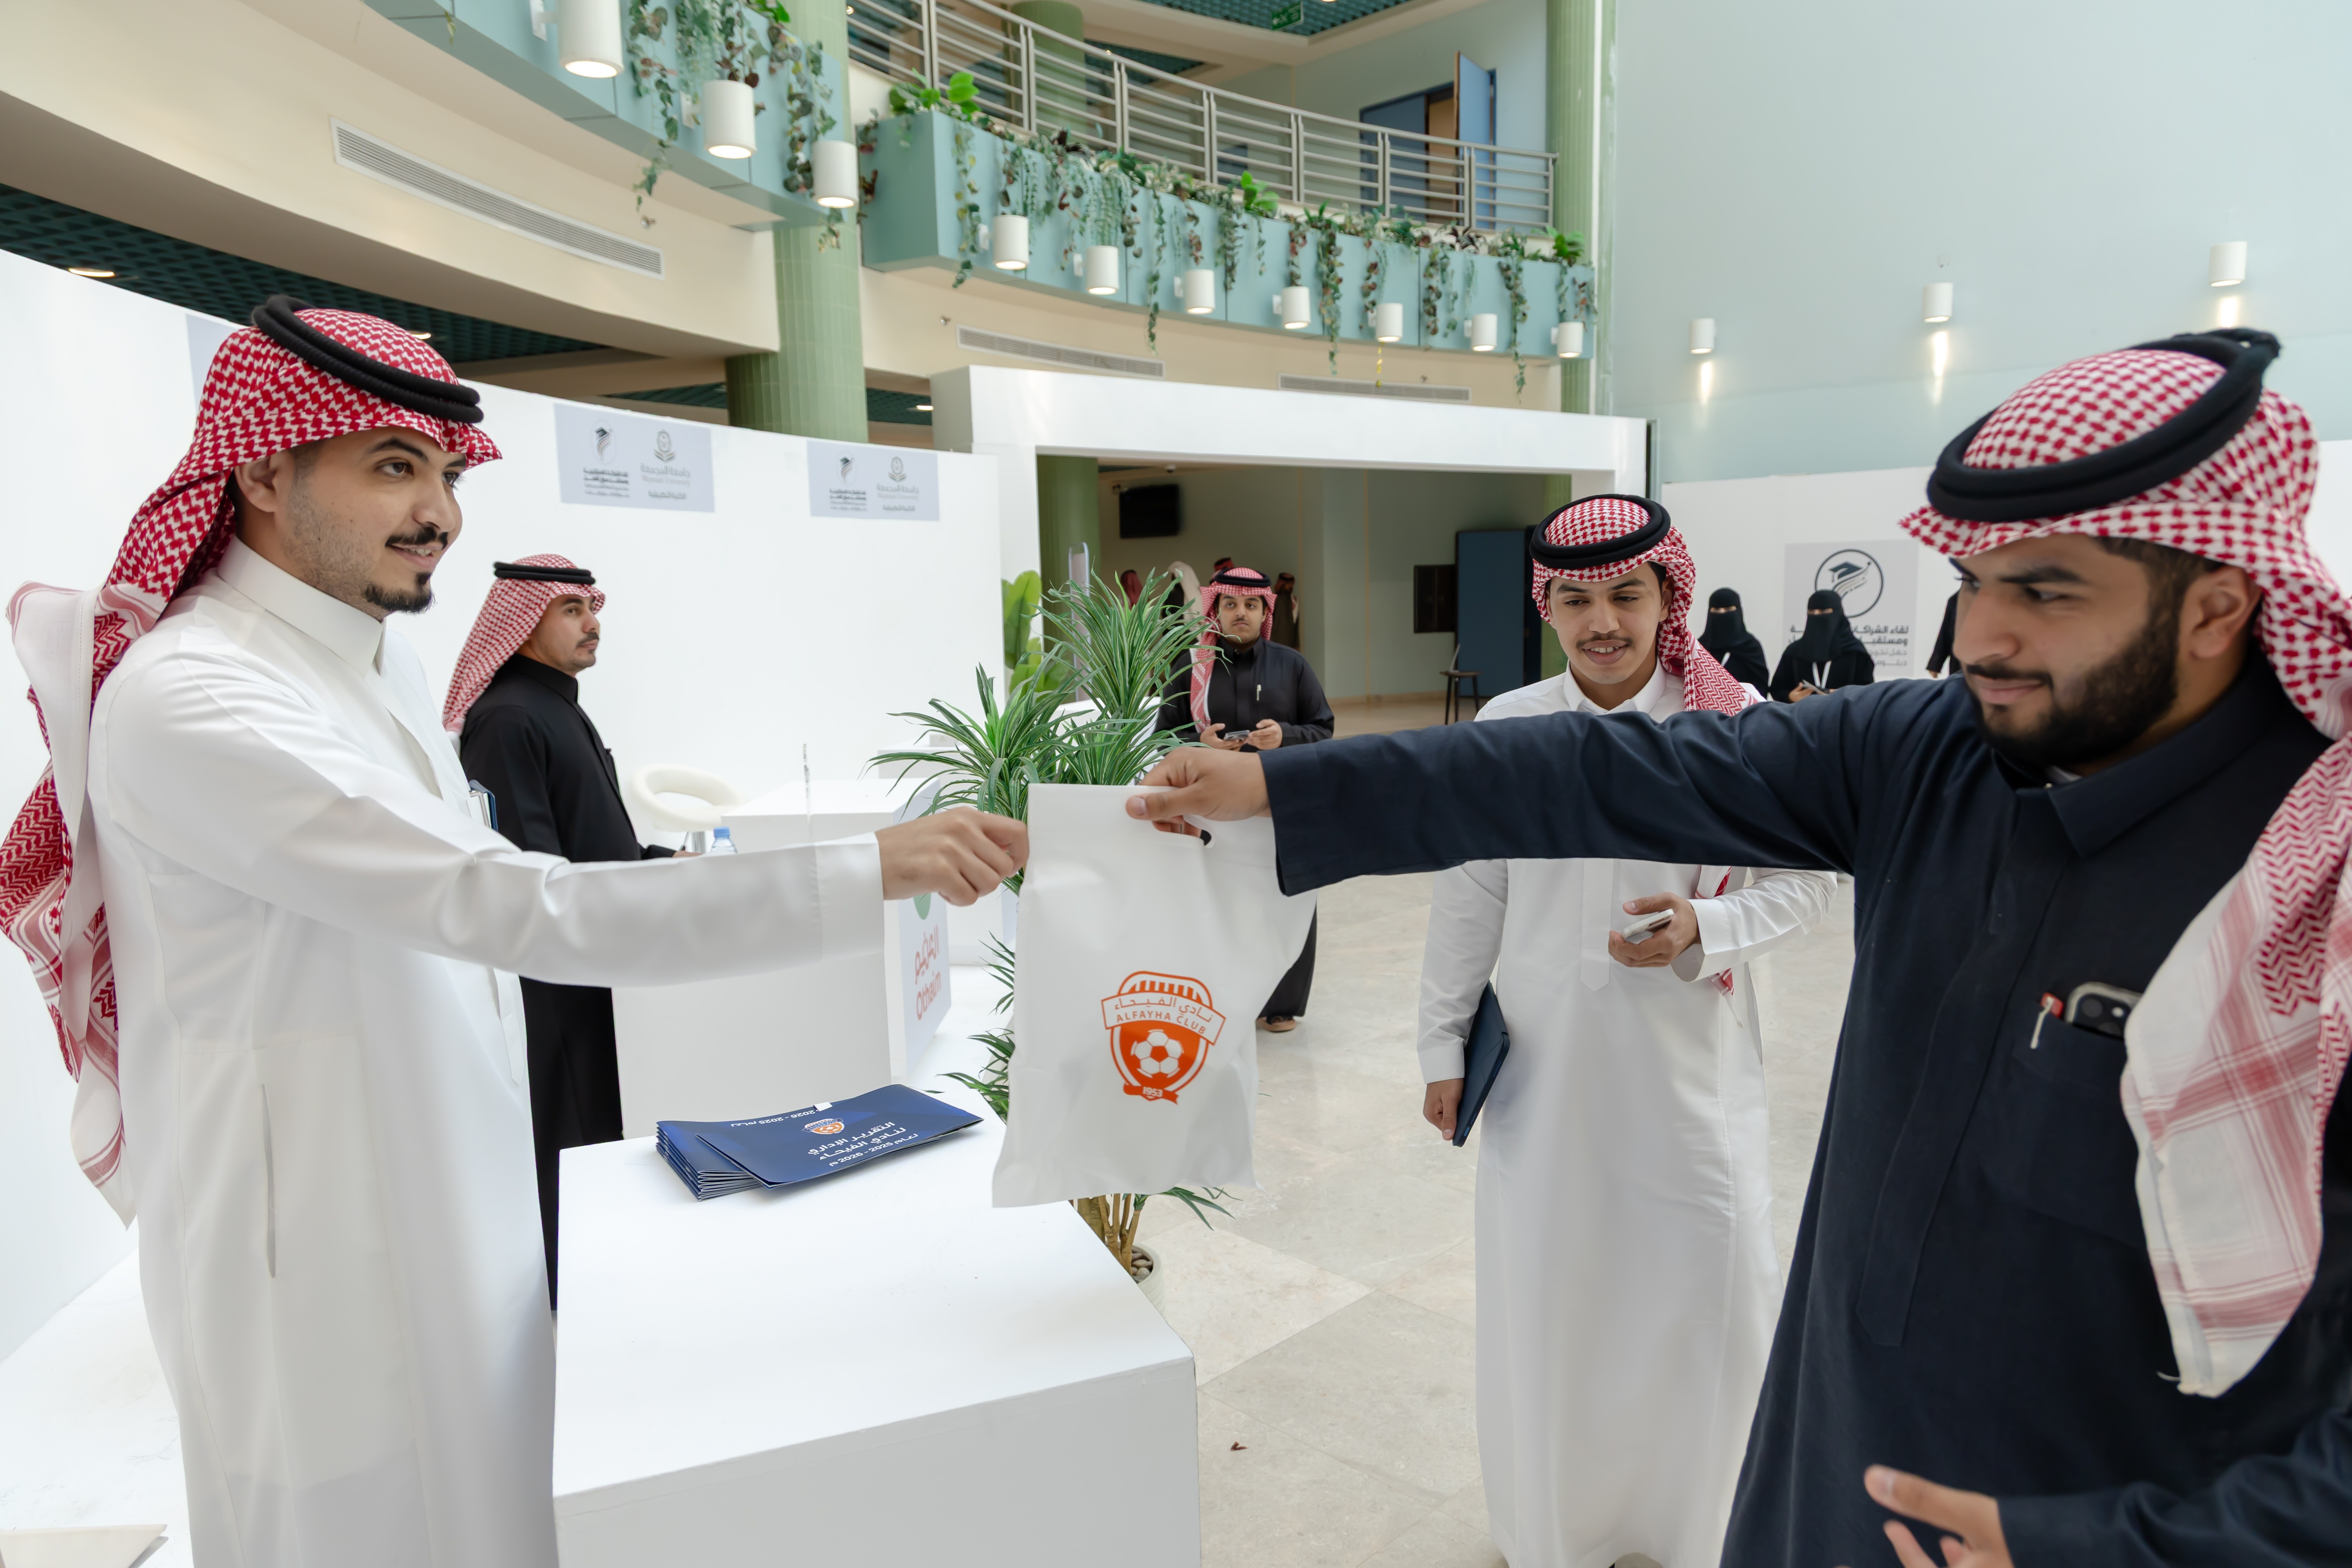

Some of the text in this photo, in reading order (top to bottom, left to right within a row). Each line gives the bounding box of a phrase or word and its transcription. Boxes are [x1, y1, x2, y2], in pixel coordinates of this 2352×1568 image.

[1854, 624, 1909, 635] لقاء الشراكا
[915, 924, 940, 985] العثيم
[916, 971, 941, 1020] Othaim
[1115, 996, 1214, 1023] نادي الفيحاء
[1116, 1010, 1206, 1034] ALFAYHA CLUB
[1142, 1087, 1163, 1098] 1953
[790, 1110, 816, 1118] 2026
[851, 1122, 896, 1142] التقرير
[894, 1133, 919, 1145] لعام
[808, 1138, 849, 1156] الإداري
[819, 1127, 906, 1160] لنادي الفيحاء
[868, 1142, 894, 1152] 2025
[840, 1152, 864, 1163] 2026
